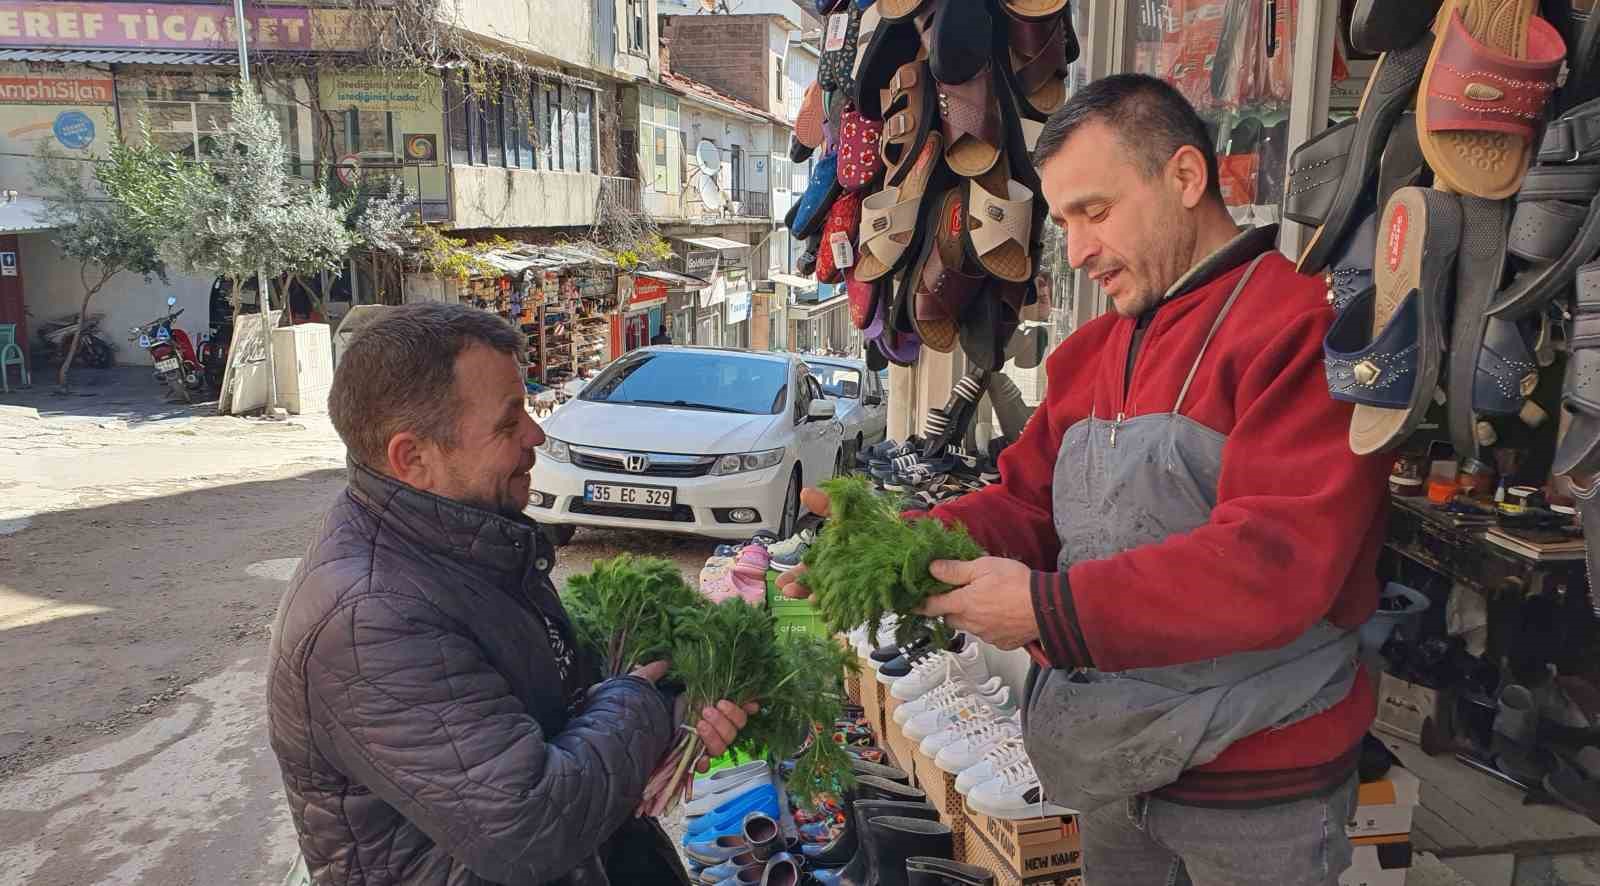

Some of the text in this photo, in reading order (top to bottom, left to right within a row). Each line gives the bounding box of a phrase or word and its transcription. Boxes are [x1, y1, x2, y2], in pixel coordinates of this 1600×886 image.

[117, 8, 304, 43] TİCARET
[595, 486, 670, 504] 35 EC 329
[1024, 851, 1080, 872] NEW KAMP
